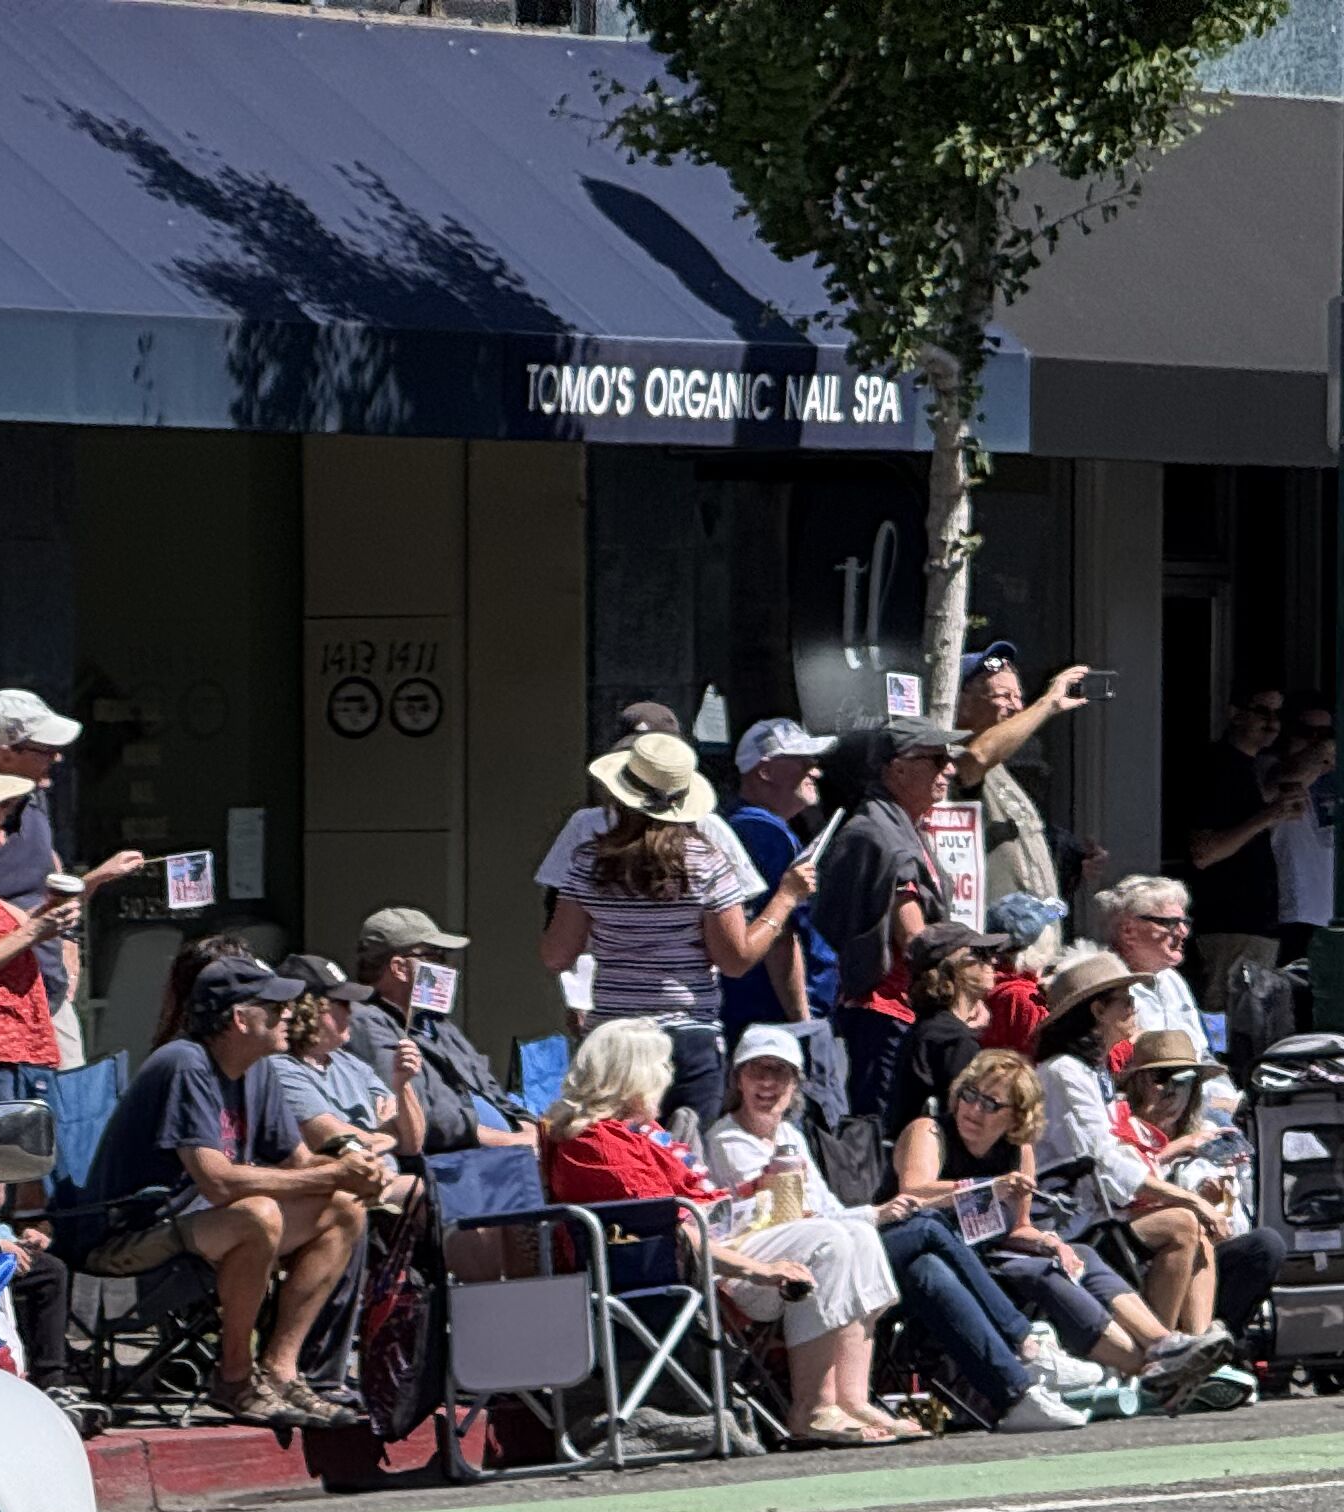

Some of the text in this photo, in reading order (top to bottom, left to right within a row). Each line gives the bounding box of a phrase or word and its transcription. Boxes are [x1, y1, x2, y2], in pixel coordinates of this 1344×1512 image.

[526, 363, 903, 424] TOMO'S ORGANIC NAIL SPA
[939, 835, 971, 849] JULY
